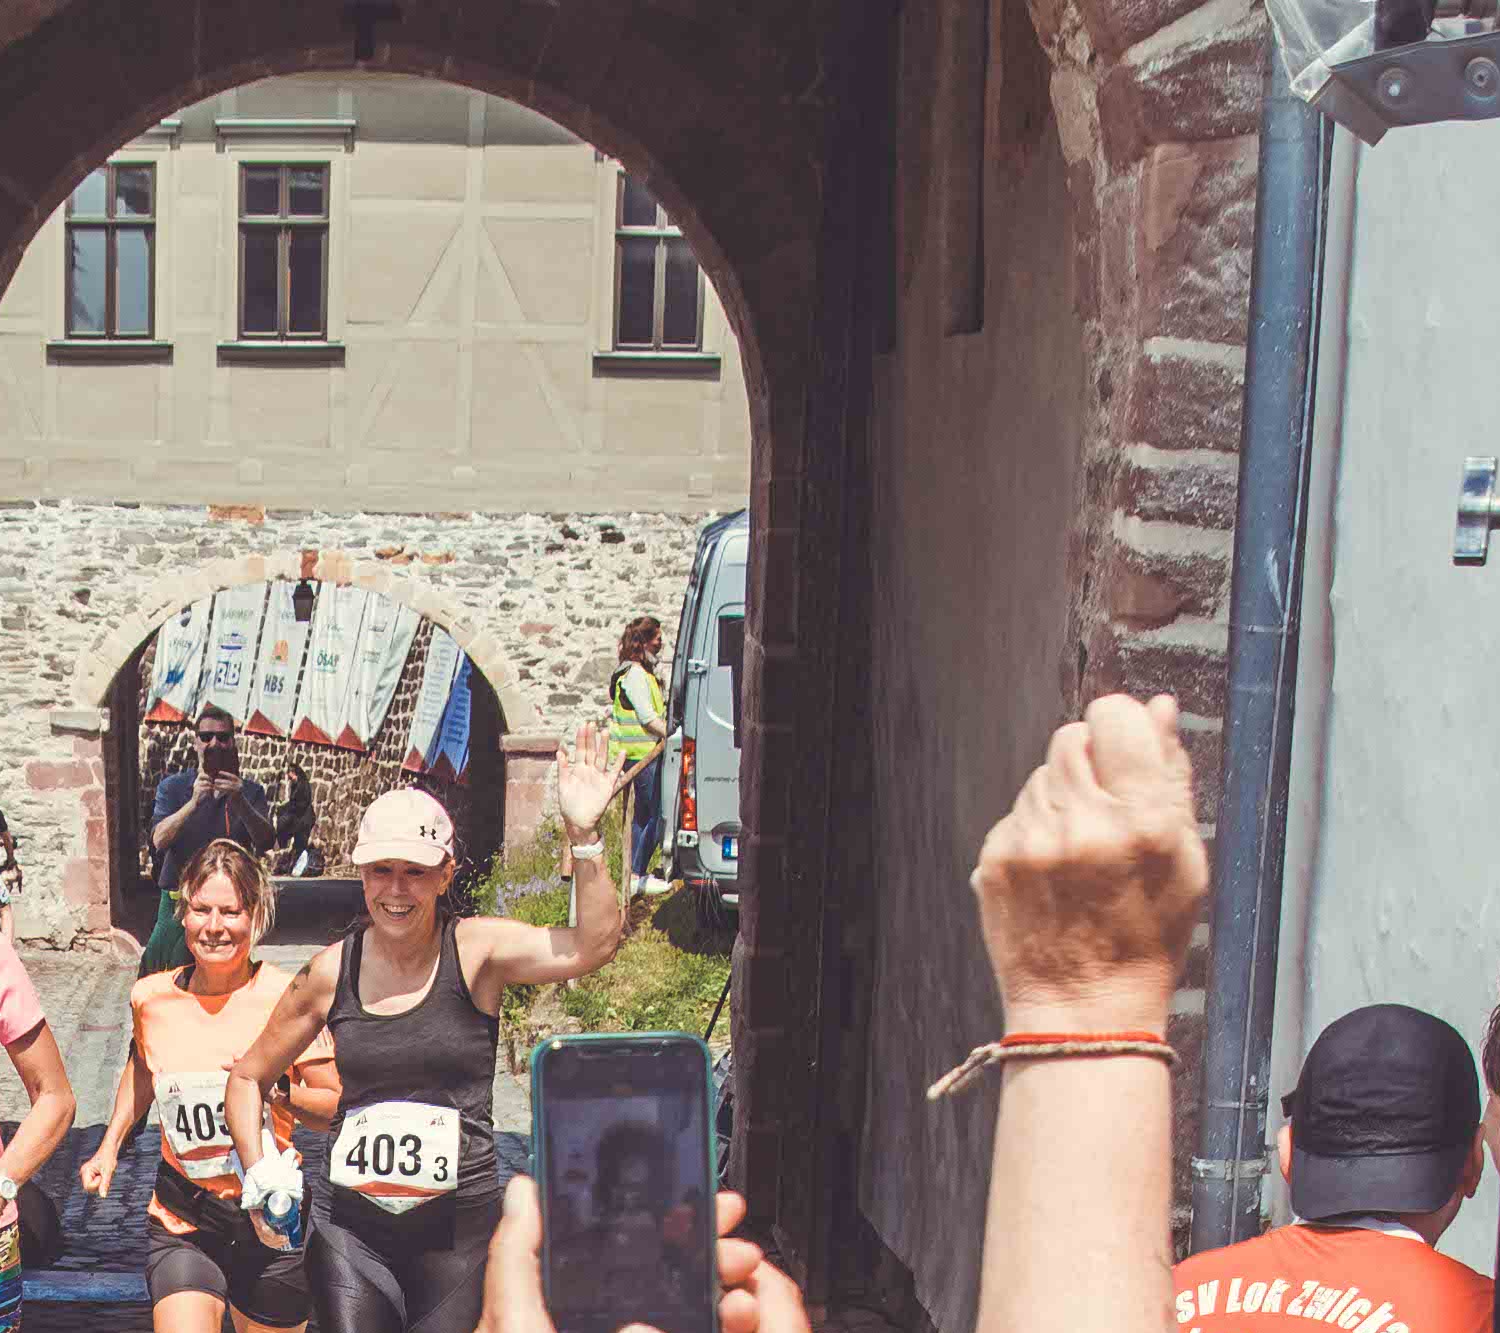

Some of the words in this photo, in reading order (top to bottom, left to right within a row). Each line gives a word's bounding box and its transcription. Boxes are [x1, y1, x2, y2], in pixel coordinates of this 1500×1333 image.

[345, 1133, 423, 1177] 403
[433, 1156, 449, 1182] 3
[1175, 1280, 1220, 1323] SV
[1226, 1278, 1292, 1314] Lok
